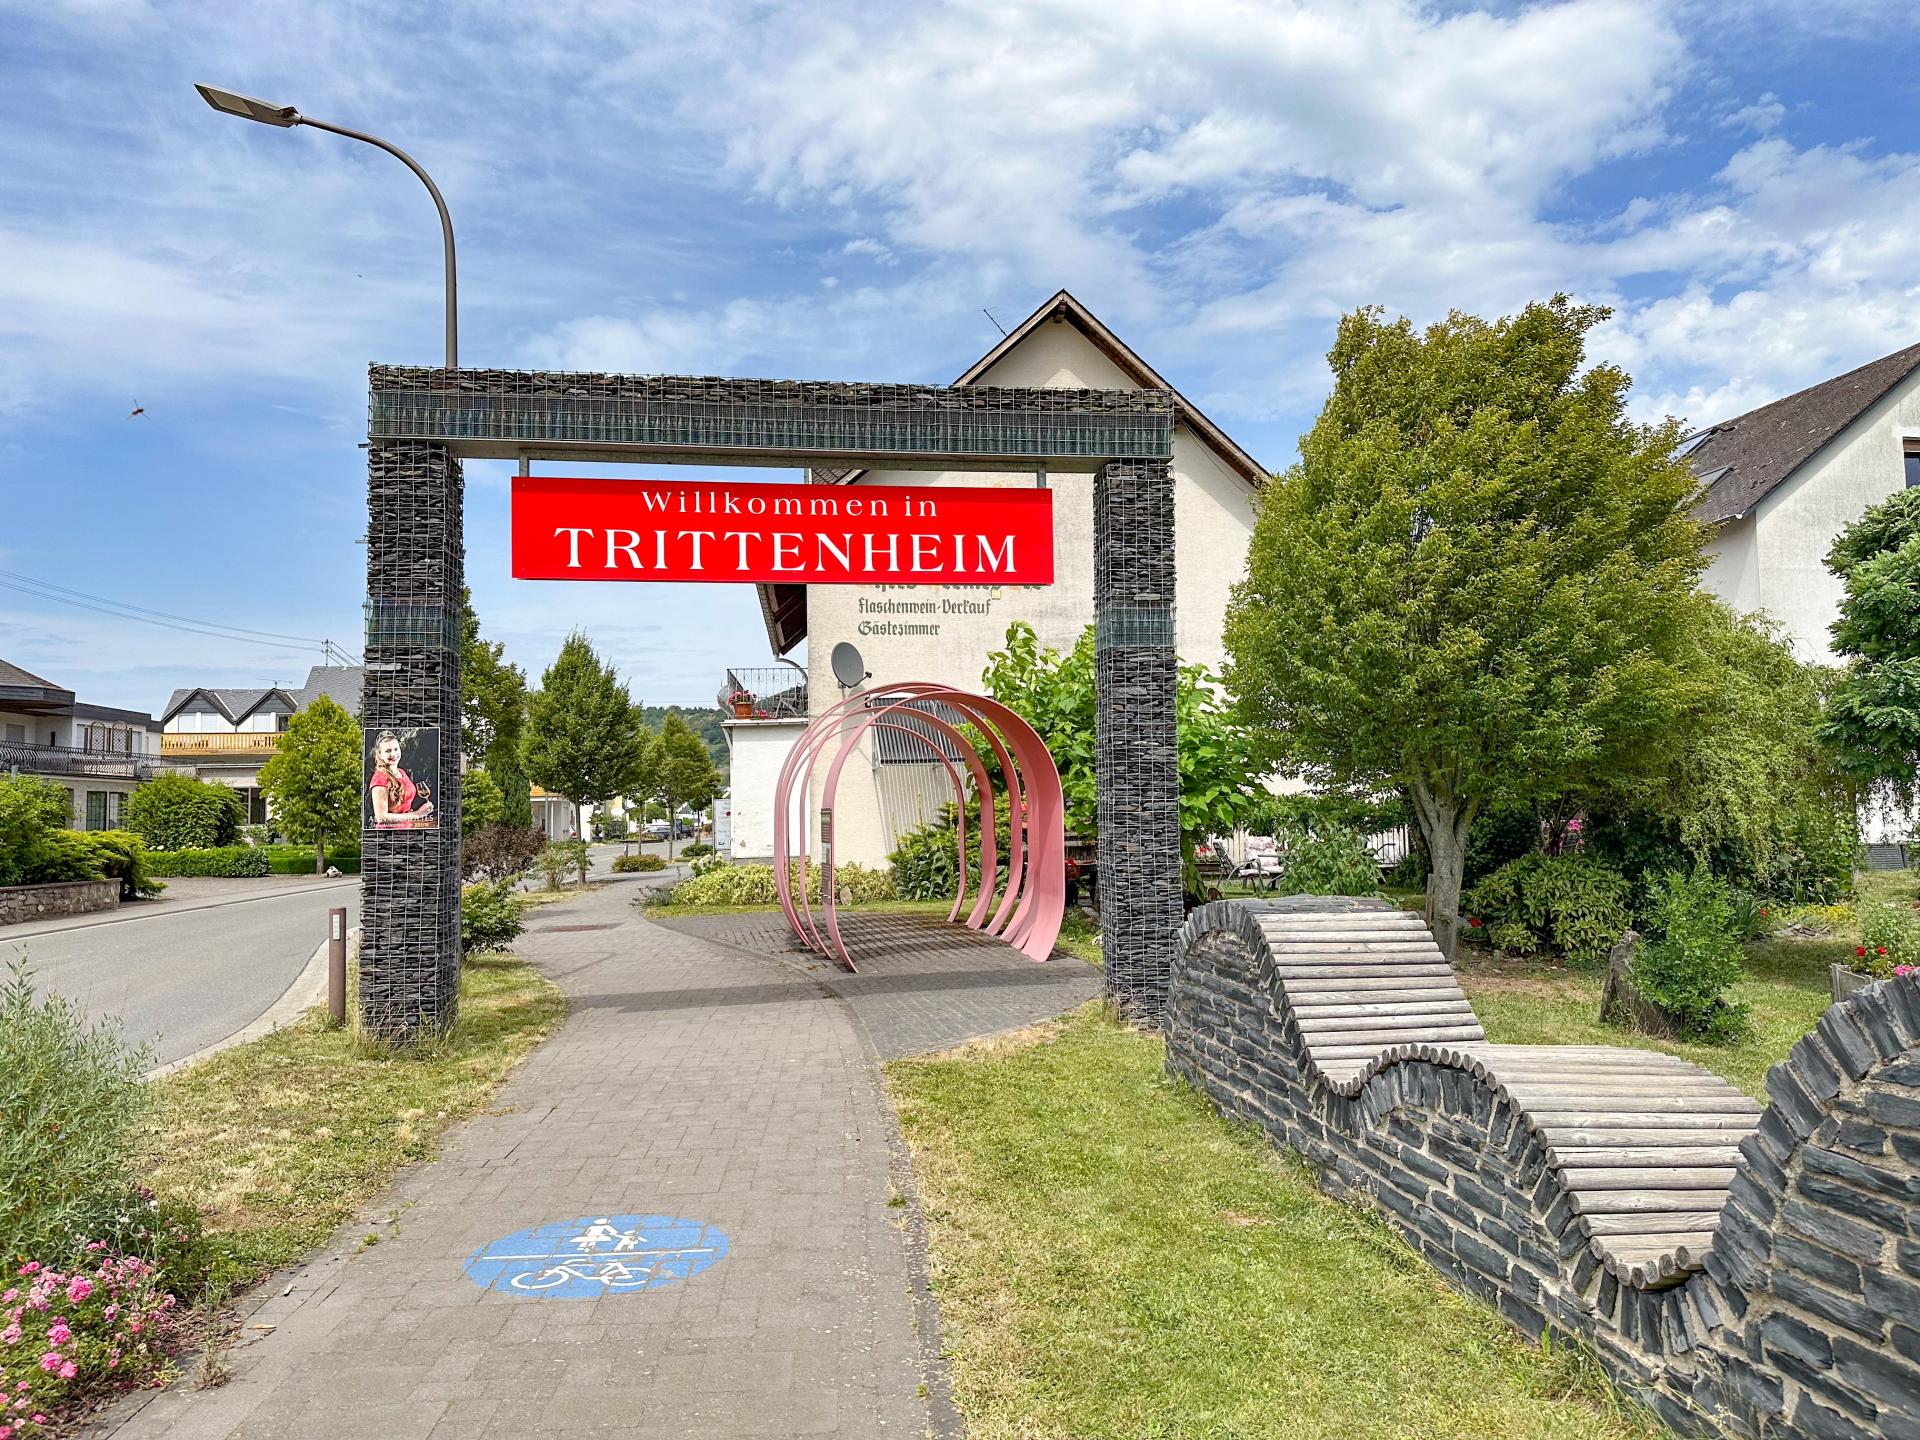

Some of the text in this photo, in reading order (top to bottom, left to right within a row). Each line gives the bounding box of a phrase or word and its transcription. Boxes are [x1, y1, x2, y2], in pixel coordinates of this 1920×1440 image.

[641, 491, 937, 517] Willkommen in
[554, 527, 1017, 573] TRITTENHEIM
[858, 597, 991, 616] Flaschenwein-Verkauf
[857, 620, 941, 637] Gästezimmer
